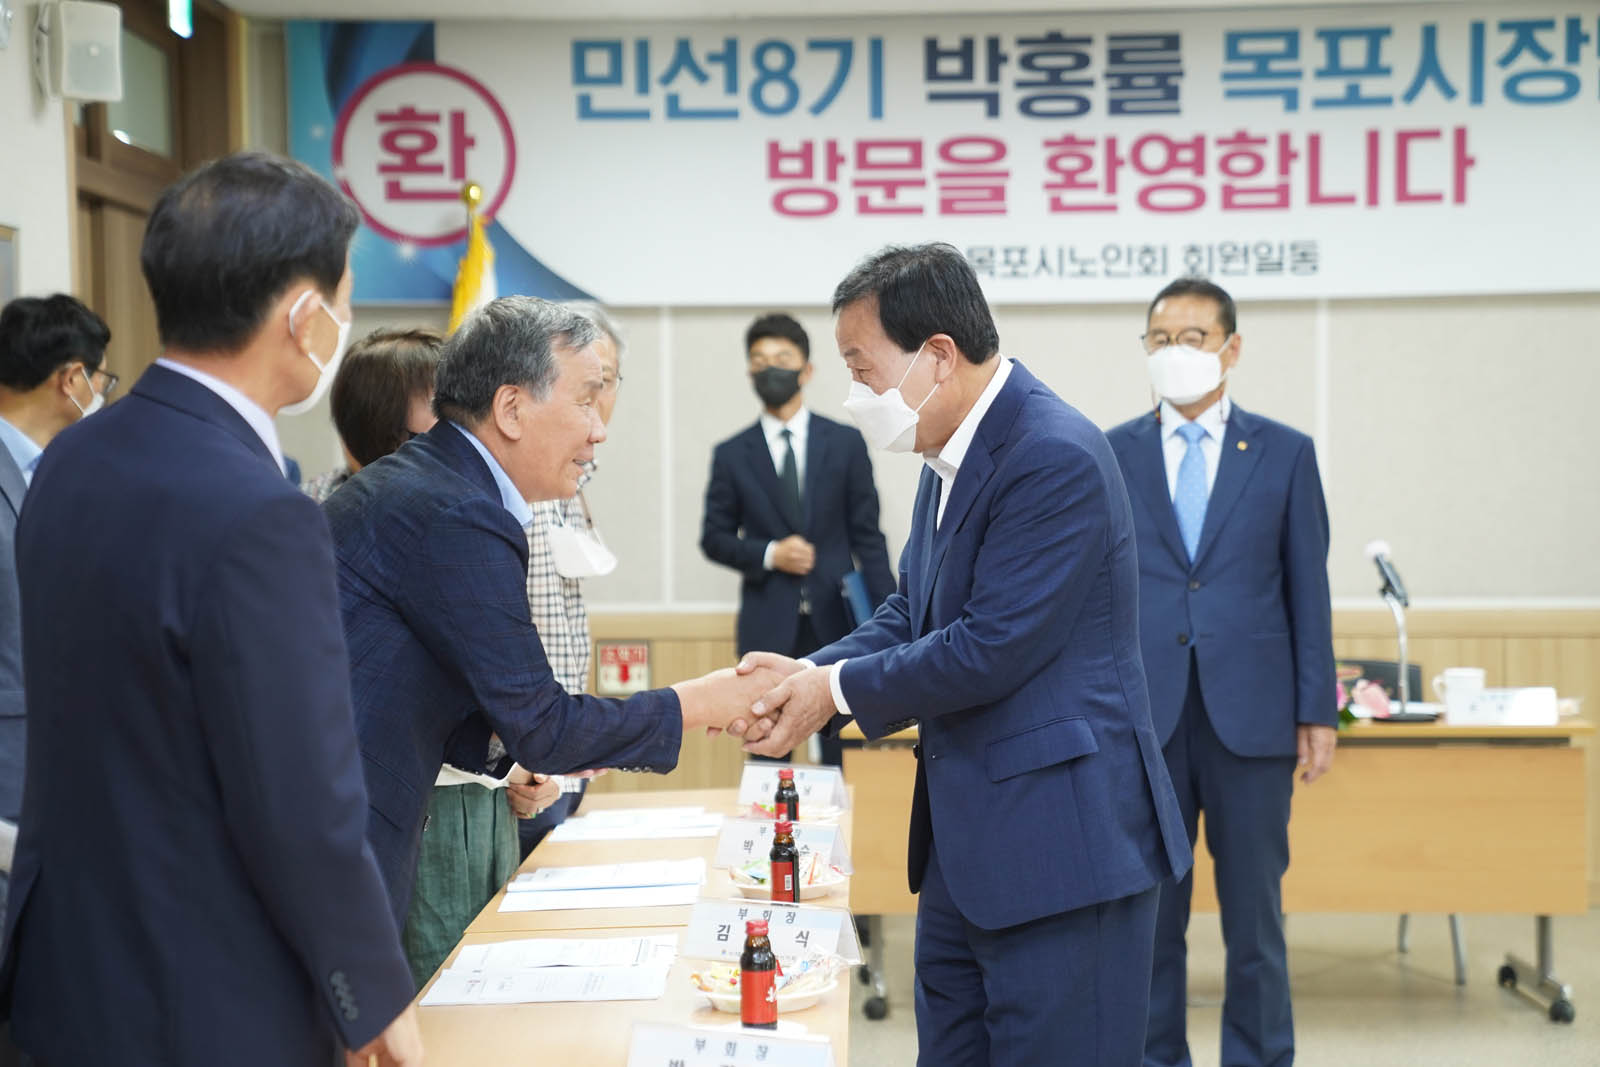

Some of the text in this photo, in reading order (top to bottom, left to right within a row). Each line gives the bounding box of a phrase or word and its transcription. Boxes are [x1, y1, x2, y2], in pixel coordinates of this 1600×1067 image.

[571, 16, 1600, 120] 민선8기 박홍률 목포시장
[375, 106, 477, 202] 환
[767, 127, 1475, 218] 방문을 환영합니다
[967, 240, 1320, 279] 목포시노인회 회원일동
